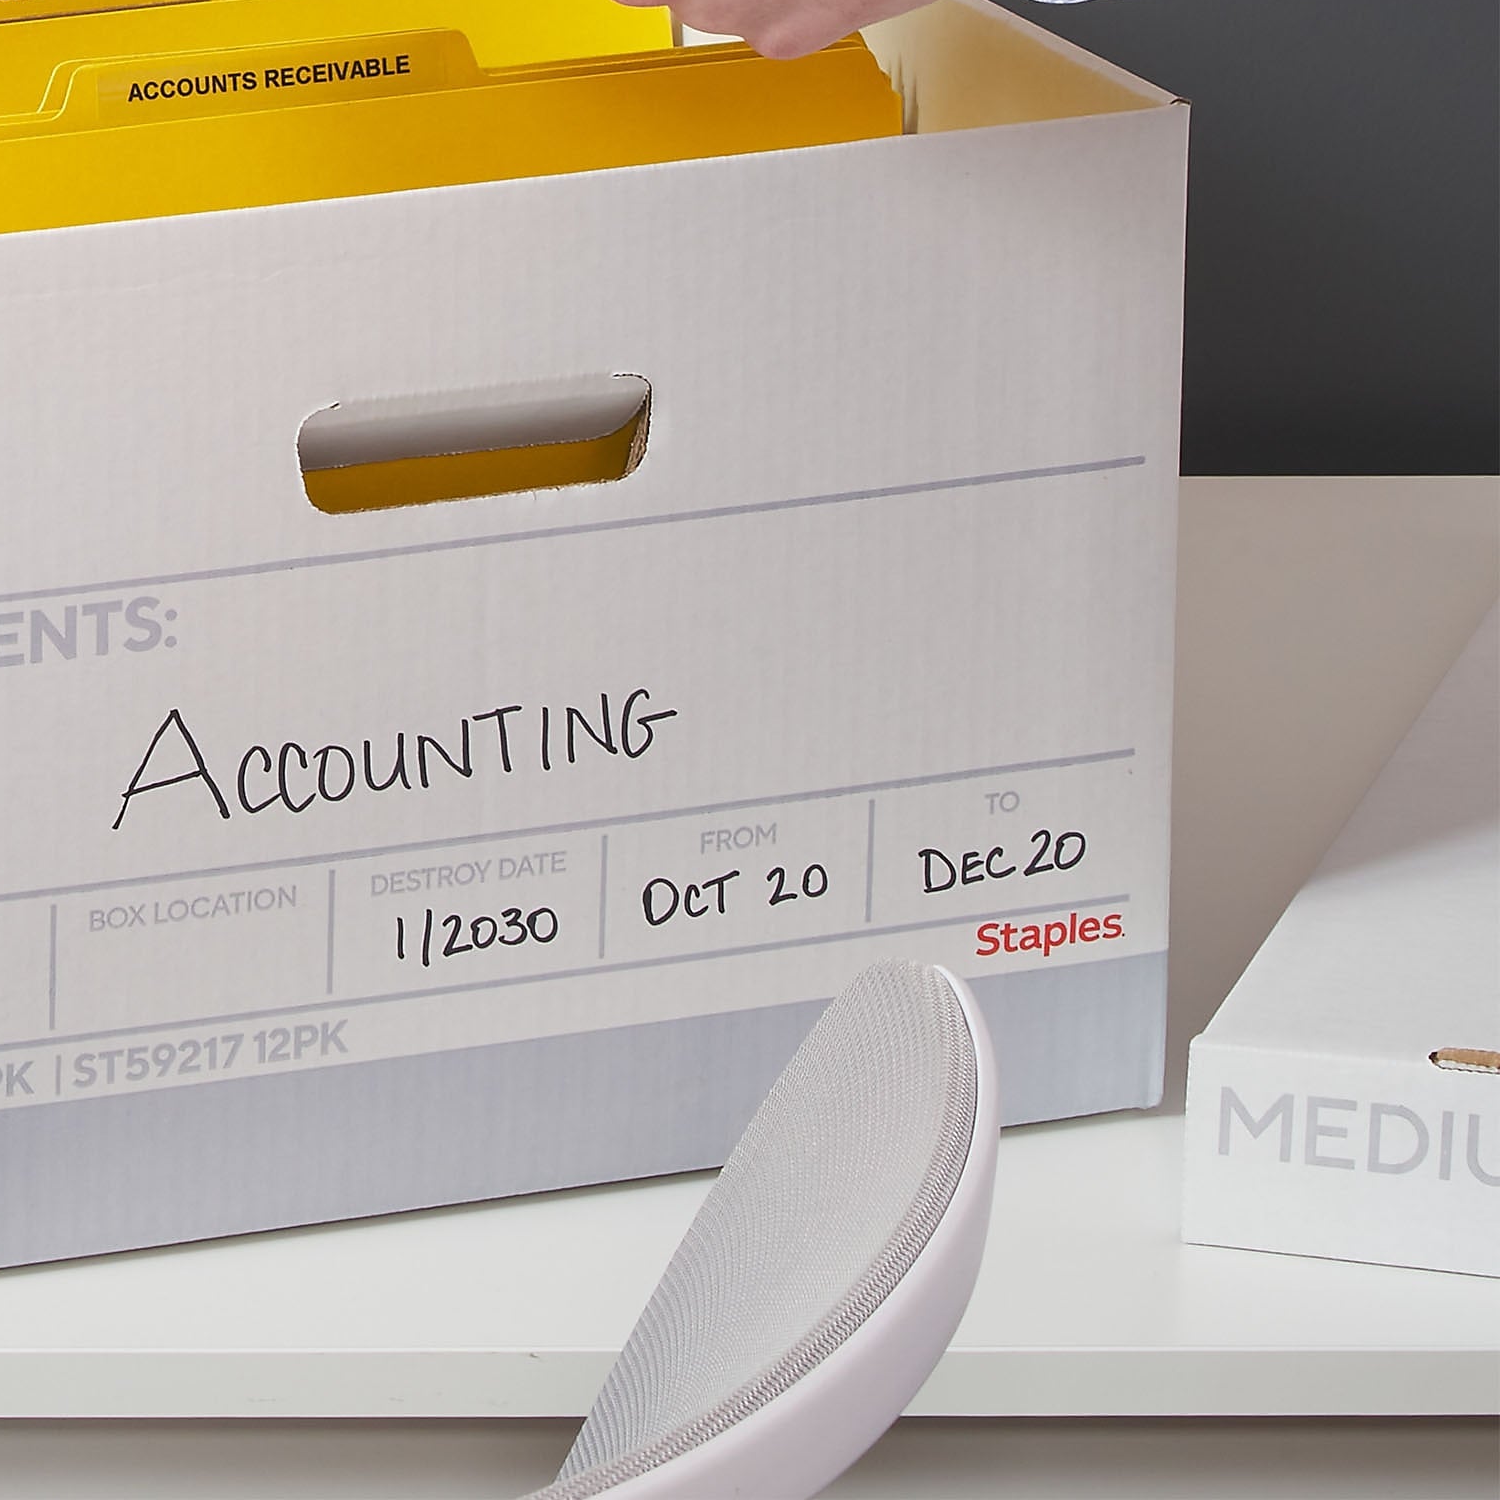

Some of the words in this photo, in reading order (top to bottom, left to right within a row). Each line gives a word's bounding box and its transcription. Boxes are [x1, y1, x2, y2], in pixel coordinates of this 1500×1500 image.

[127, 71, 257, 103] ACCOUNTS
[264, 54, 411, 89] RECEIVABLE
[111, 688, 678, 830] ACCOUNTING
[984, 790, 1021, 815] TO
[700, 822, 777, 854] FROM
[917, 846, 1017, 894] DEC
[1023, 829, 1087, 878] 20
[371, 861, 492, 896] DESTROY
[499, 850, 567, 882] DATE
[642, 870, 741, 927] OCT
[766, 863, 828, 903] 20
[88, 904, 147, 933] BOX
[154, 884, 298, 925] LOCATION
[396, 907, 559, 968] 1/2030
[73, 1035, 244, 1088] ST59217
[251, 1019, 350, 1065] 12PK
